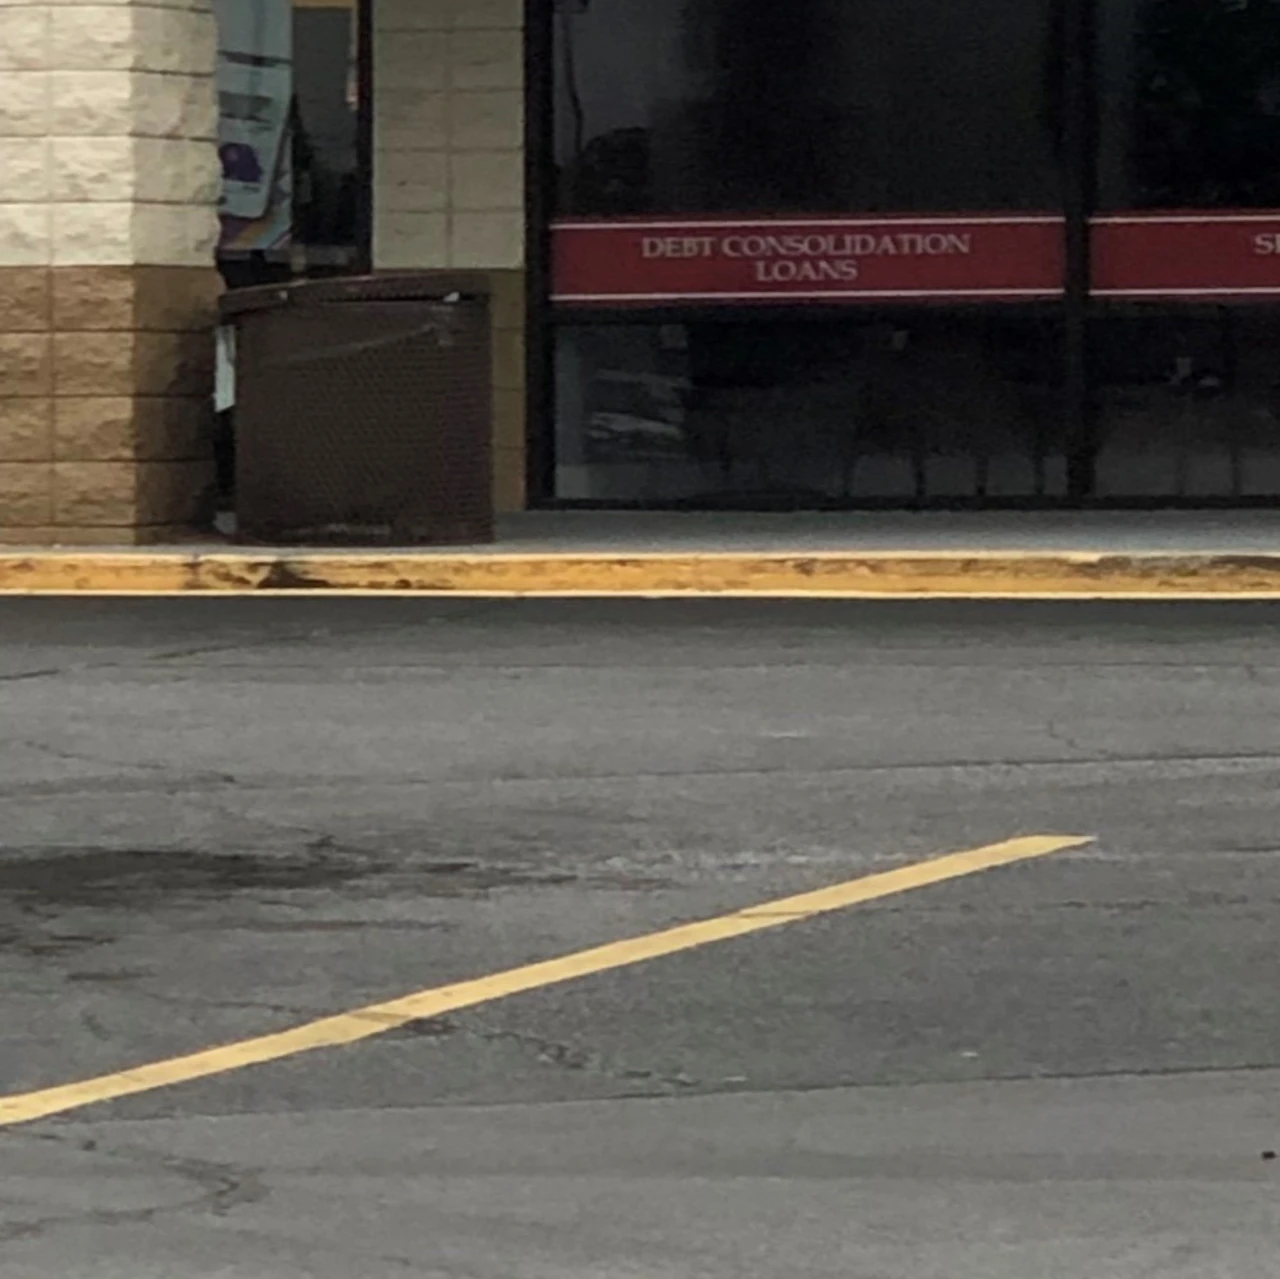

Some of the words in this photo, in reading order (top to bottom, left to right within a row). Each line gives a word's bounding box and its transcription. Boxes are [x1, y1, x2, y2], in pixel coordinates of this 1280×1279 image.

[642, 236, 714, 258] DEBT
[721, 233, 971, 257] CONSOLIDATION
[756, 259, 859, 282] LOANS
